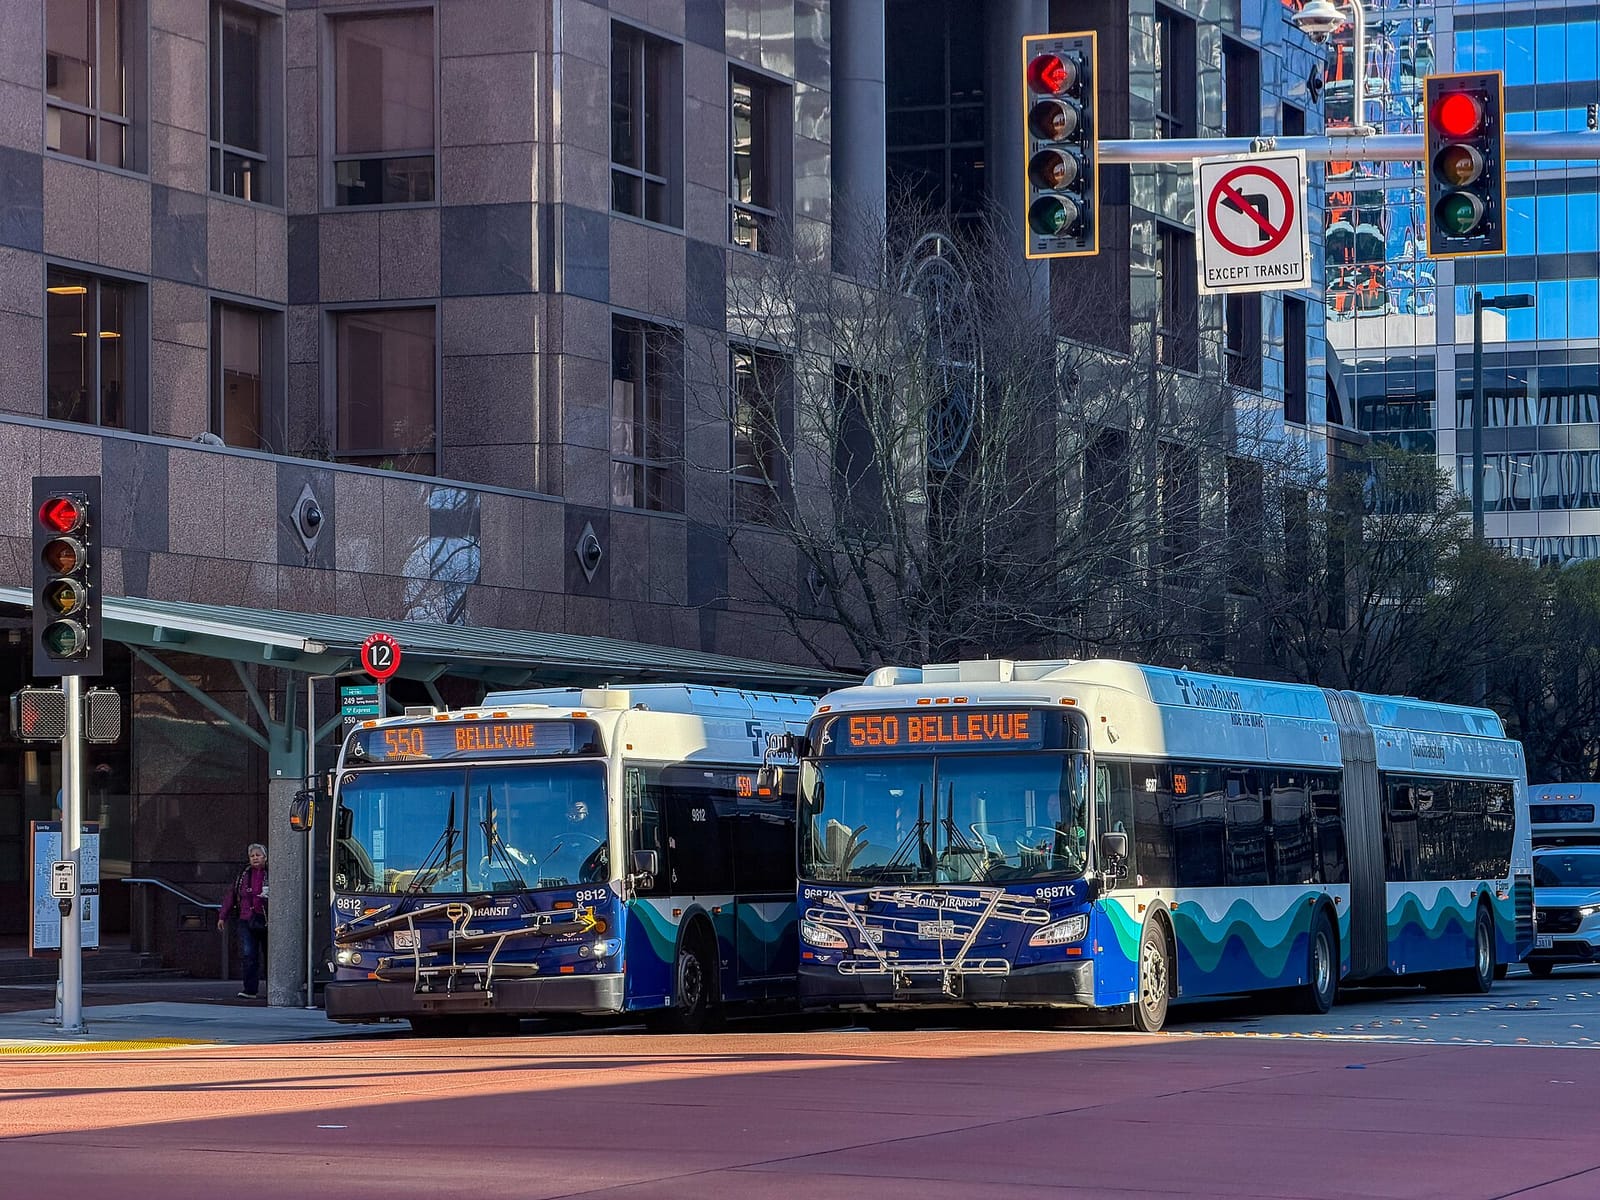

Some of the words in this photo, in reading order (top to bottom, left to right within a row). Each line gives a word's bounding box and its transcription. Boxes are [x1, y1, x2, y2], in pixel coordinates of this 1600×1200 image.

[1208, 266, 1250, 280] EXCEPT
[1254, 262, 1300, 277] TRANSIT
[366, 634, 379, 647] BUS
[383, 634, 396, 647] BAY
[370, 645, 391, 666] 12
[343, 696, 355, 705] 249
[344, 716, 356, 725] 550
[1241, 713, 1251, 727] THE
[1251, 714, 1264, 728] WAVE
[849, 715, 899, 746] 550
[907, 712, 1030, 743] BELLEVUE
[384, 728, 425, 756] 550
[455, 723, 535, 751] BELLEVUE
[738, 775, 752, 797] 550
[1145, 778, 1157, 793] 9687
[1174, 774, 1187, 794] 550
[691, 808, 706, 822] 9812
[575, 888, 607, 902] 9812
[1036, 884, 1076, 899] 9687K
[336, 898, 361, 910] 9812
[354, 909, 361, 917] K
